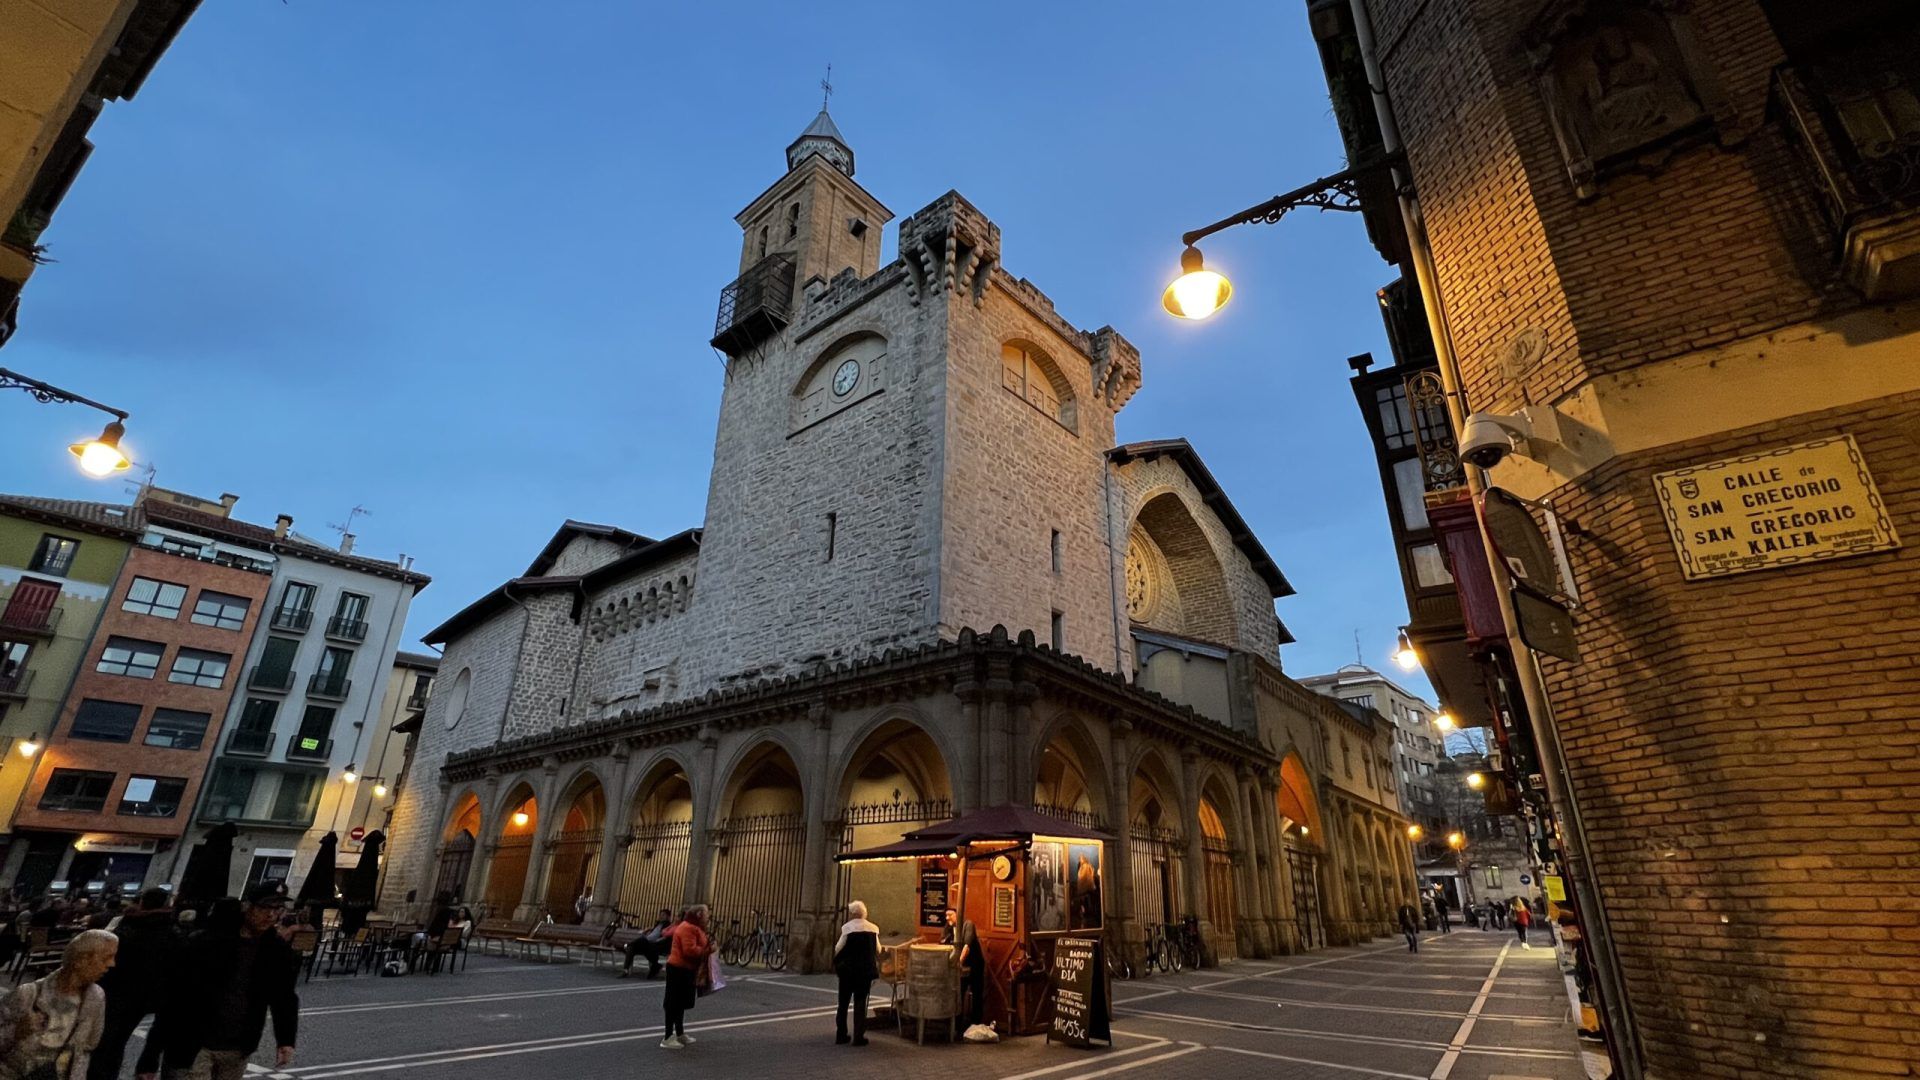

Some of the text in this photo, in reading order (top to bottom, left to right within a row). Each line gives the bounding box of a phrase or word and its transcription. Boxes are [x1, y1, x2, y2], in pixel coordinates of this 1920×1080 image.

[1723, 465, 1816, 490] CALLE de
[1687, 477, 1842, 519] SAN GREGORIO
[1694, 504, 1856, 545] SAN GREGORIO
[1747, 531, 1819, 555] KALEA
[1060, 969, 1077, 982] DIA
